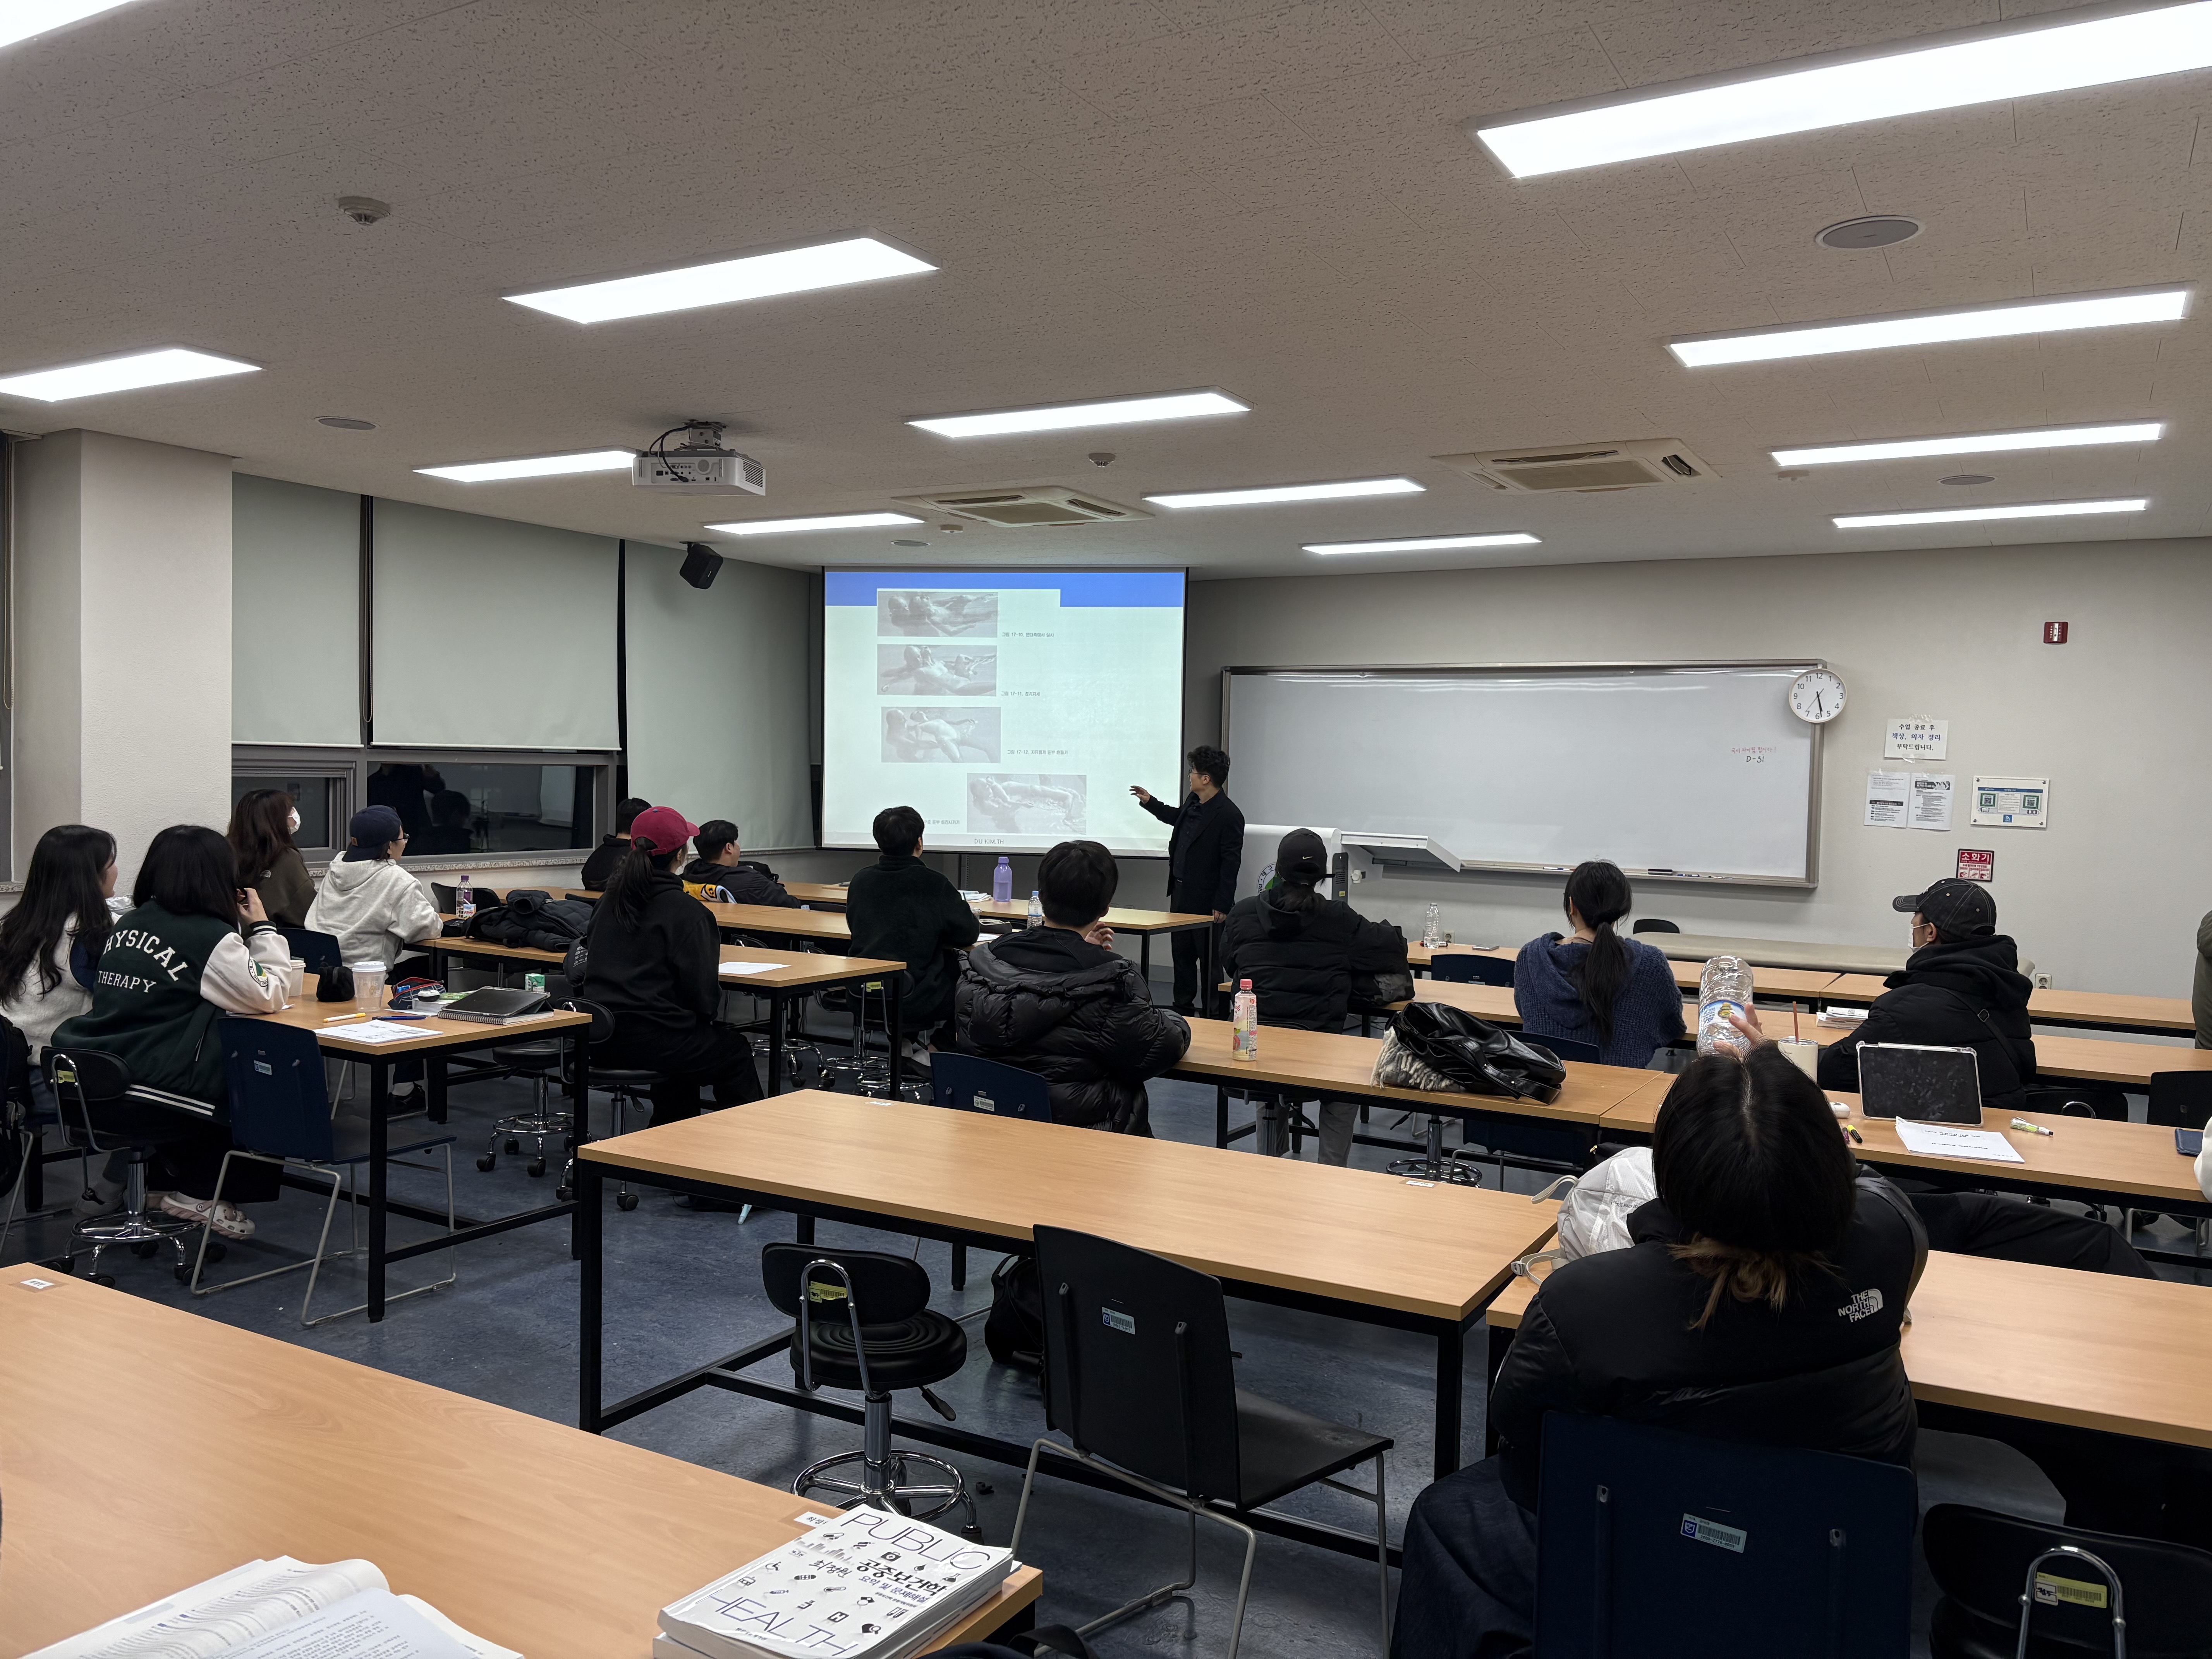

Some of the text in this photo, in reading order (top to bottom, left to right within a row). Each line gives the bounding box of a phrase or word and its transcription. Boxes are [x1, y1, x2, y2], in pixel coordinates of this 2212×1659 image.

[1961, 853, 1989, 862] 소화기
[103, 929, 188, 981] HYSICAL
[98, 971, 156, 993] THERAPY
[1838, 1298, 1869, 1317] NORTH
[1851, 1290, 1868, 1303] THE
[1849, 1307, 1871, 1322] FACE
[841, 1513, 991, 1570] PUBLIC
[809, 1559, 852, 1578] 최정원
[857, 1559, 948, 1596] 공중보건학
[859, 1576, 880, 1586] 요약
[891, 1587, 930, 1603] 문제해설
[710, 1597, 859, 1657] HEALTH
